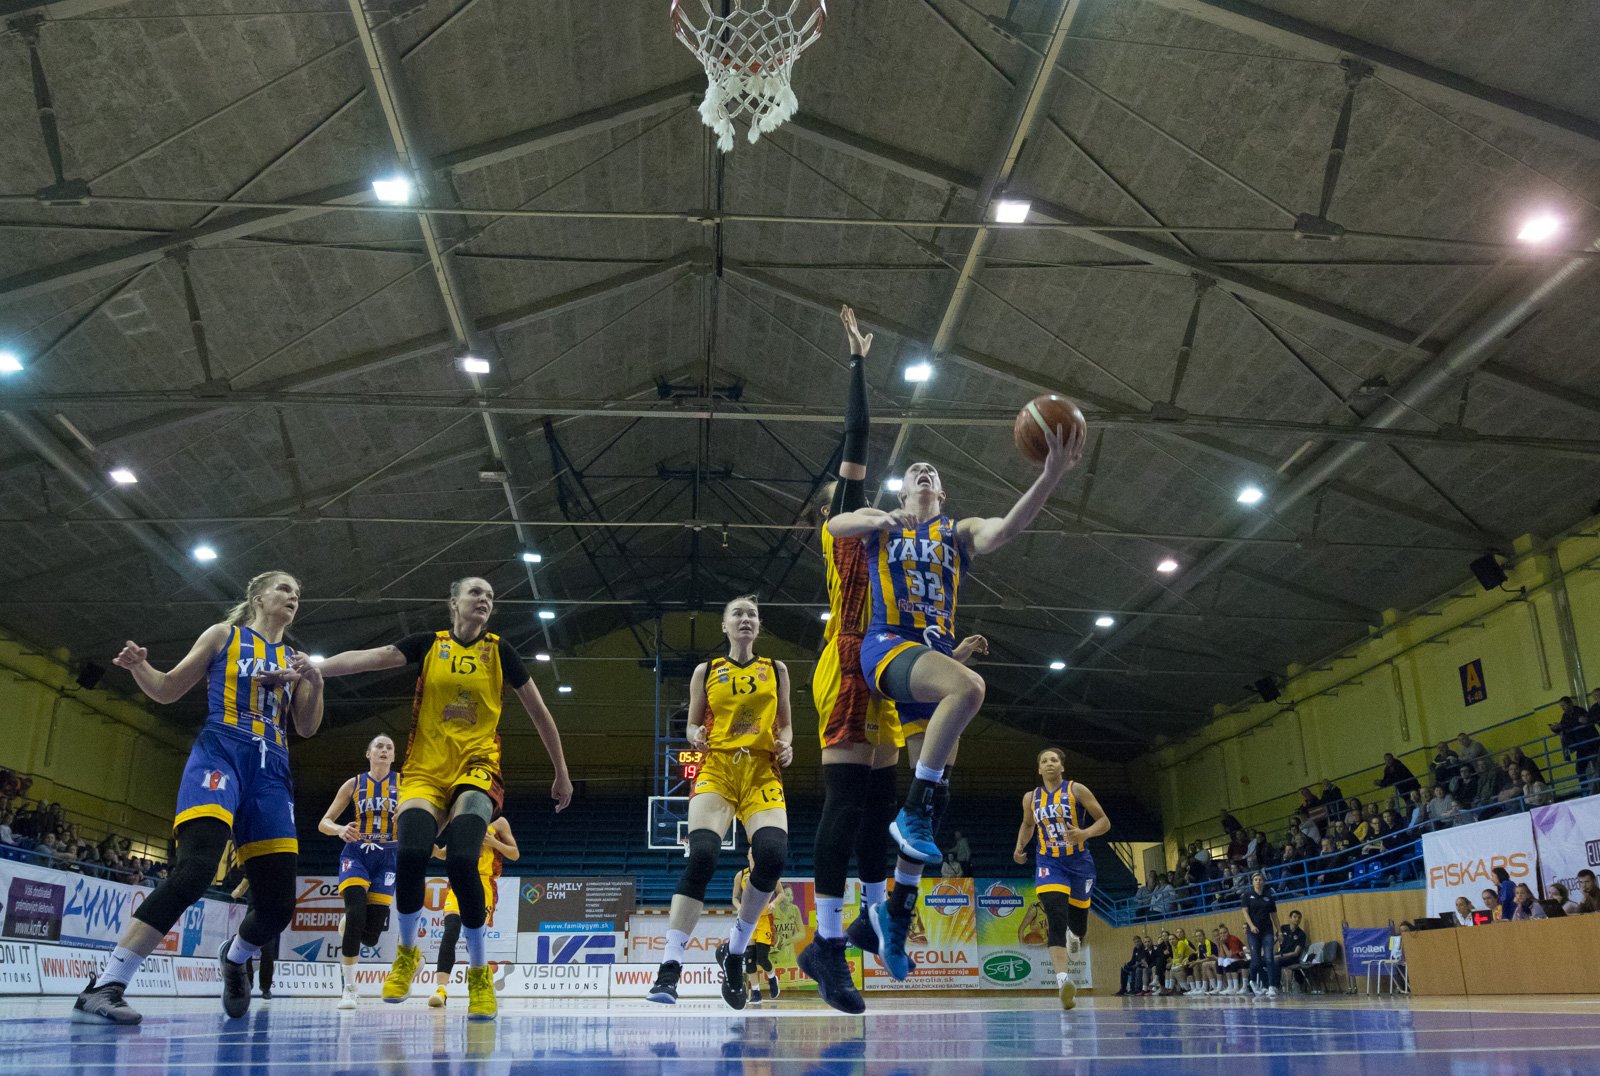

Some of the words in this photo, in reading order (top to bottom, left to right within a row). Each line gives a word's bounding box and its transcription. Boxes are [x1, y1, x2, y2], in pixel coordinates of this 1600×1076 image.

[886, 538, 958, 575] YAKE
[906, 569, 944, 602] 32
[451, 655, 477, 675] 15
[1467, 663, 1481, 692] A
[732, 675, 758, 696] 13
[684, 765, 696, 779] 19
[761, 788, 784, 803] 13
[358, 797, 398, 814] YAKE
[1033, 803, 1073, 823] YAKE
[373, 815, 382, 830] 4
[1047, 822, 1067, 839] 24
[1429, 852, 1530, 889] FISKARS
[296, 879, 342, 904] Zoz
[546, 882, 583, 891] FAMILY
[546, 891, 566, 900] GYM
[947, 896, 968, 904] ANGELS
[62, 878, 127, 935] LYNX
[296, 912, 345, 927] PREDPR
[544, 922, 609, 931] www.familygym.sk
[327, 943, 381, 958] trex
[632, 936, 730, 951] FISAR
[1353, 944, 1386, 954] molten
[19, 945, 31, 965] IT
[3, 972, 32, 983] TIONS
[176, 961, 223, 983] www.visionit.s
[323, 964, 336, 977] IT
[523, 965, 580, 978] VISION
[587, 965, 604, 978] IT
[615, 966, 727, 985] www.ionit.s
[948, 967, 970, 978] zdroje
[136, 979, 172, 988] SOLUTIONS
[271, 981, 335, 989] SOLUTIONS
[889, 975, 955, 984] ww.veolia.sk
